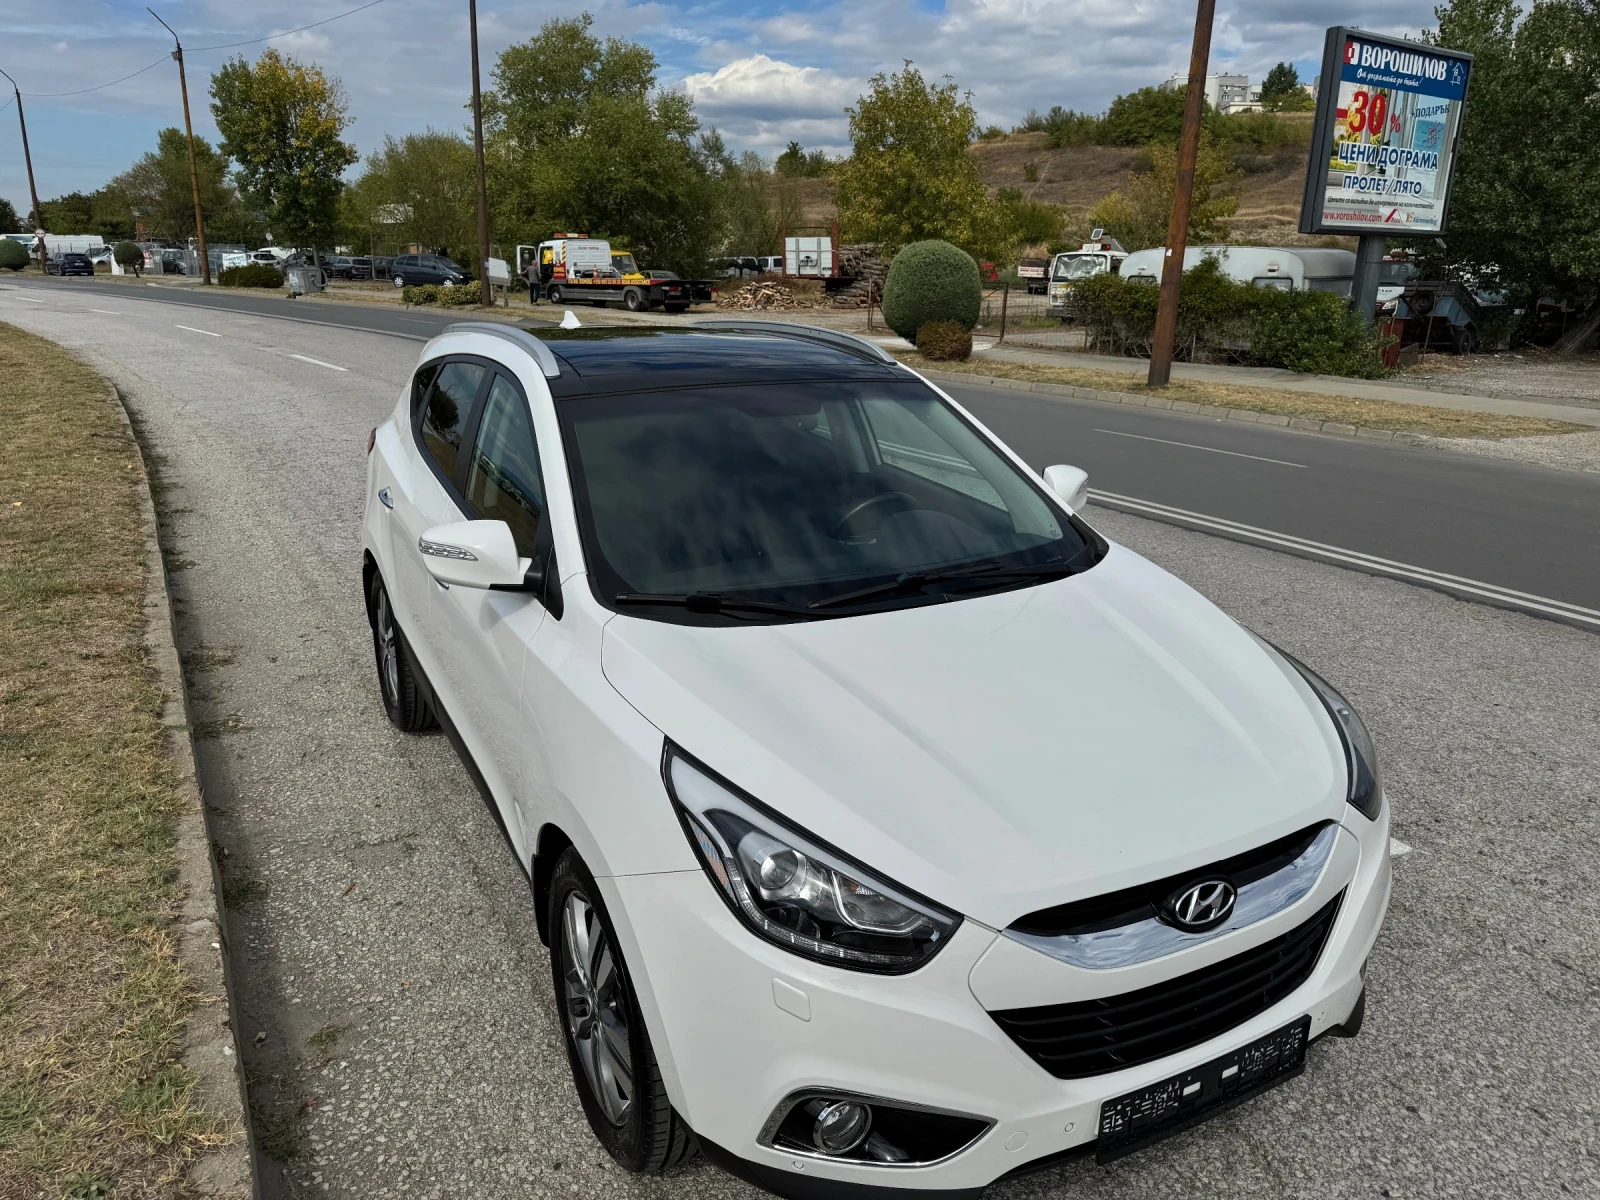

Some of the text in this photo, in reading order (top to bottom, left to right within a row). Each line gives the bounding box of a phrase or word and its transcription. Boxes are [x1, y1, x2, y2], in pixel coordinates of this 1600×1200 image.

[1361, 45, 1448, 81] ВОРОШИЛОВ
[1340, 142, 1438, 170] ЦЕНИ ДОГРАМА
[1343, 175, 1423, 196] ПРОЛЕТ/ЛЯТО
